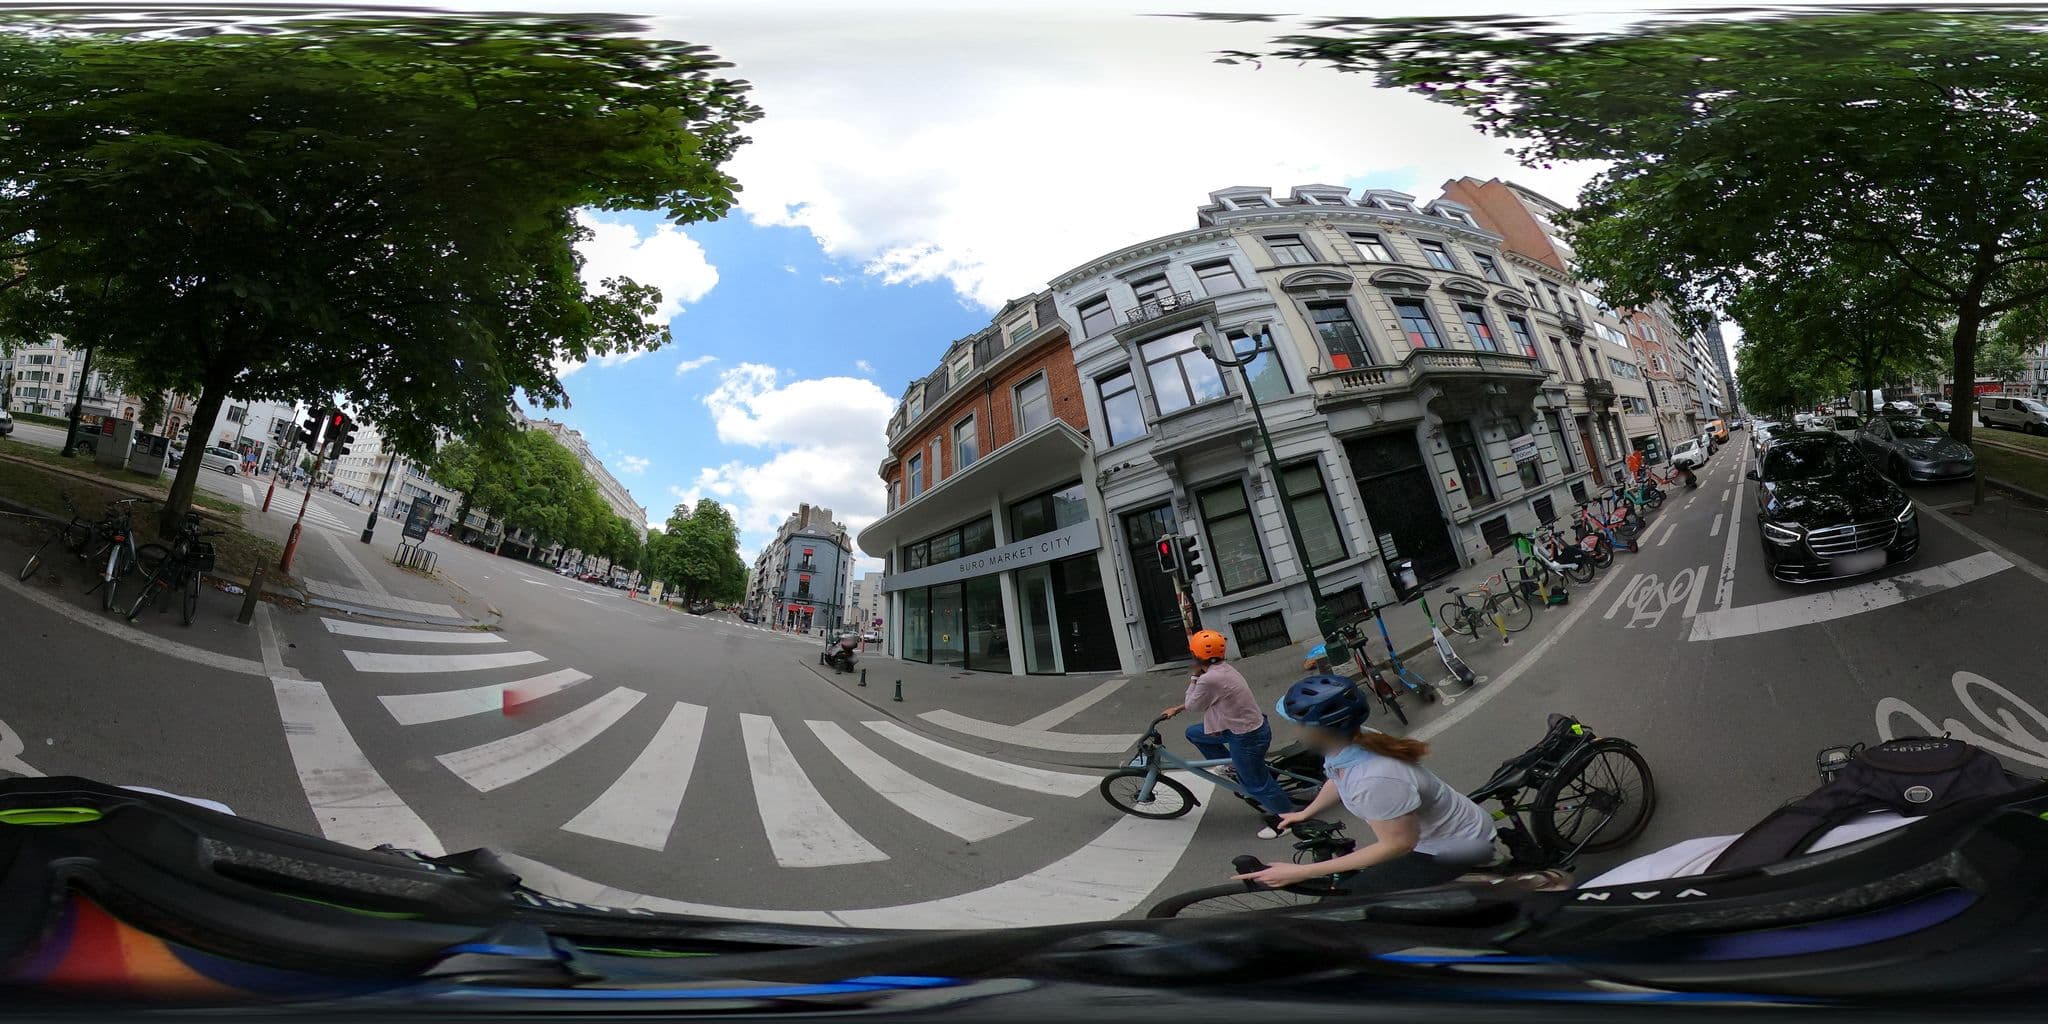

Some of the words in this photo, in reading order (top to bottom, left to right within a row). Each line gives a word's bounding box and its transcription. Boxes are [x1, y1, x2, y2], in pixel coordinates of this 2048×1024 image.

[960, 559, 984, 573] BURO
[990, 546, 1033, 565] MARKET
[1041, 536, 1071, 553] CITY
